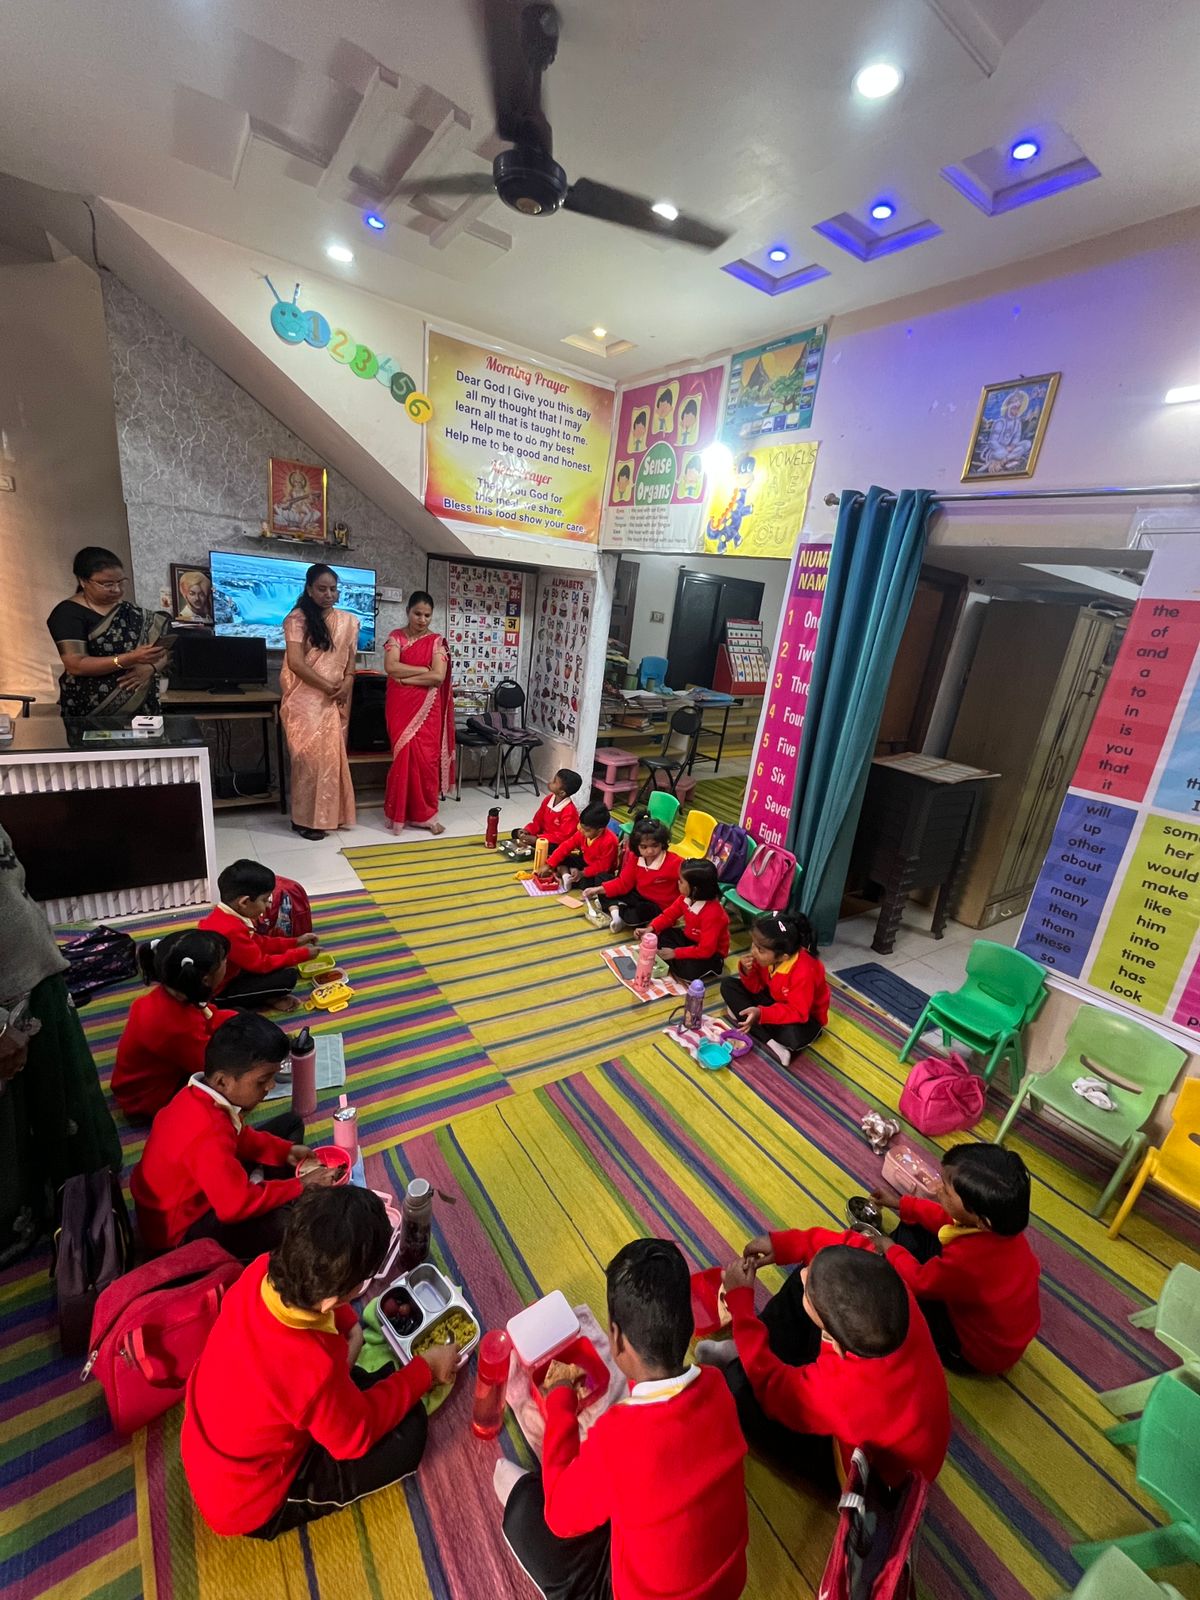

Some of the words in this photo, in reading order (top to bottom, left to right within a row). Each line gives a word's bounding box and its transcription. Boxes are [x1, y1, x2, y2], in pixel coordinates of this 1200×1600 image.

[309, 315, 323, 342] 1
[331, 330, 348, 359] 2
[355, 349, 371, 372] 3
[486, 355, 532, 385] Morning
[535, 371, 570, 395] Prayer
[393, 376, 414, 397] 5
[456, 370, 481, 386] Dear
[484, 378, 505, 395] God
[507, 386, 511, 396] I
[513, 387, 536, 403] Give
[538, 398, 555, 411] you
[557, 399, 575, 415] this
[576, 408, 592, 423] day
[409, 398, 431, 417] 6
[465, 389, 478, 401] all
[480, 394, 497, 408] my
[498, 399, 537, 419] thought
[539, 409, 558, 425] that
[558, 415, 562, 425] I
[564, 418, 582, 433] may
[455, 400, 482, 417] learn
[484, 409, 496, 421] all
[498, 412, 518, 427] that
[520, 417, 529, 430] is
[530, 420, 561, 439] taught
[562, 430, 571, 441] to
[572, 435, 588, 446] me.
[470, 419, 494, 437] Help
[496, 427, 511, 439] me
[513, 430, 523, 442] to
[525, 432, 538, 447] do
[539, 438, 554, 453] my
[555, 440, 576, 456] best
[445, 427, 469, 444] Help
[471, 435, 488, 448] me
[490, 438, 500, 451] to
[502, 440, 515, 455] be
[516, 446, 541, 460] good
[542, 451, 560, 465] and
[561, 456, 593, 473] honest.
[768, 448, 818, 468] VOWELS
[642, 455, 673, 477] Sense
[477, 477, 509, 493] Tha
[529, 489, 549, 502] God
[550, 492, 563, 504] for
[637, 481, 672, 504] Organs
[443, 498, 473, 513] Bless
[475, 504, 494, 517] this
[519, 513, 543, 526] show
[544, 519, 565, 530] your
[475, 491, 494, 504] this
[538, 504, 565, 518] share.
[552, 577, 584, 591] ALPHABETS
[787, 609, 794, 626] 1
[1152, 604, 1179, 618] the
[1151, 626, 1169, 638] of
[780, 642, 788, 658] 2
[1136, 646, 1168, 659] and
[1140, 668, 1151, 678] a
[774, 673, 783, 689] 3
[791, 675, 809, 696] Thre
[1131, 685, 1146, 698] to
[768, 703, 775, 719] 4
[1124, 704, 1139, 718] in
[1119, 723, 1132, 736] is
[762, 733, 769, 748] 5
[776, 736, 796, 758] Five
[1106, 742, 1134, 757] you
[756, 762, 764, 777] 6
[770, 766, 786, 786] Six
[1098, 758, 1130, 775] that
[1102, 779, 1113, 791] it
[751, 789, 758, 804] 7
[1086, 802, 1112, 818] will
[745, 816, 752, 830] 8
[758, 823, 782, 846] Eight
[1083, 822, 1102, 837] up
[1163, 825, 1200, 843] som
[1068, 837, 1106, 856] other
[1164, 843, 1195, 861] her
[1061, 853, 1102, 874] about
[1146, 860, 1200, 884] would
[1064, 873, 1087, 887] out
[1141, 878, 1189, 901] make
[1050, 886, 1089, 908] many
[1143, 897, 1172, 917] like
[1048, 902, 1079, 923] then
[1041, 917, 1076, 939] them
[1136, 915, 1167, 935] him
[1035, 931, 1072, 954] these
[1129, 931, 1160, 952] into
[1040, 951, 1056, 965] so
[1121, 947, 1157, 970] time
[1118, 965, 1147, 986] has
[1109, 980, 1143, 1003] look
